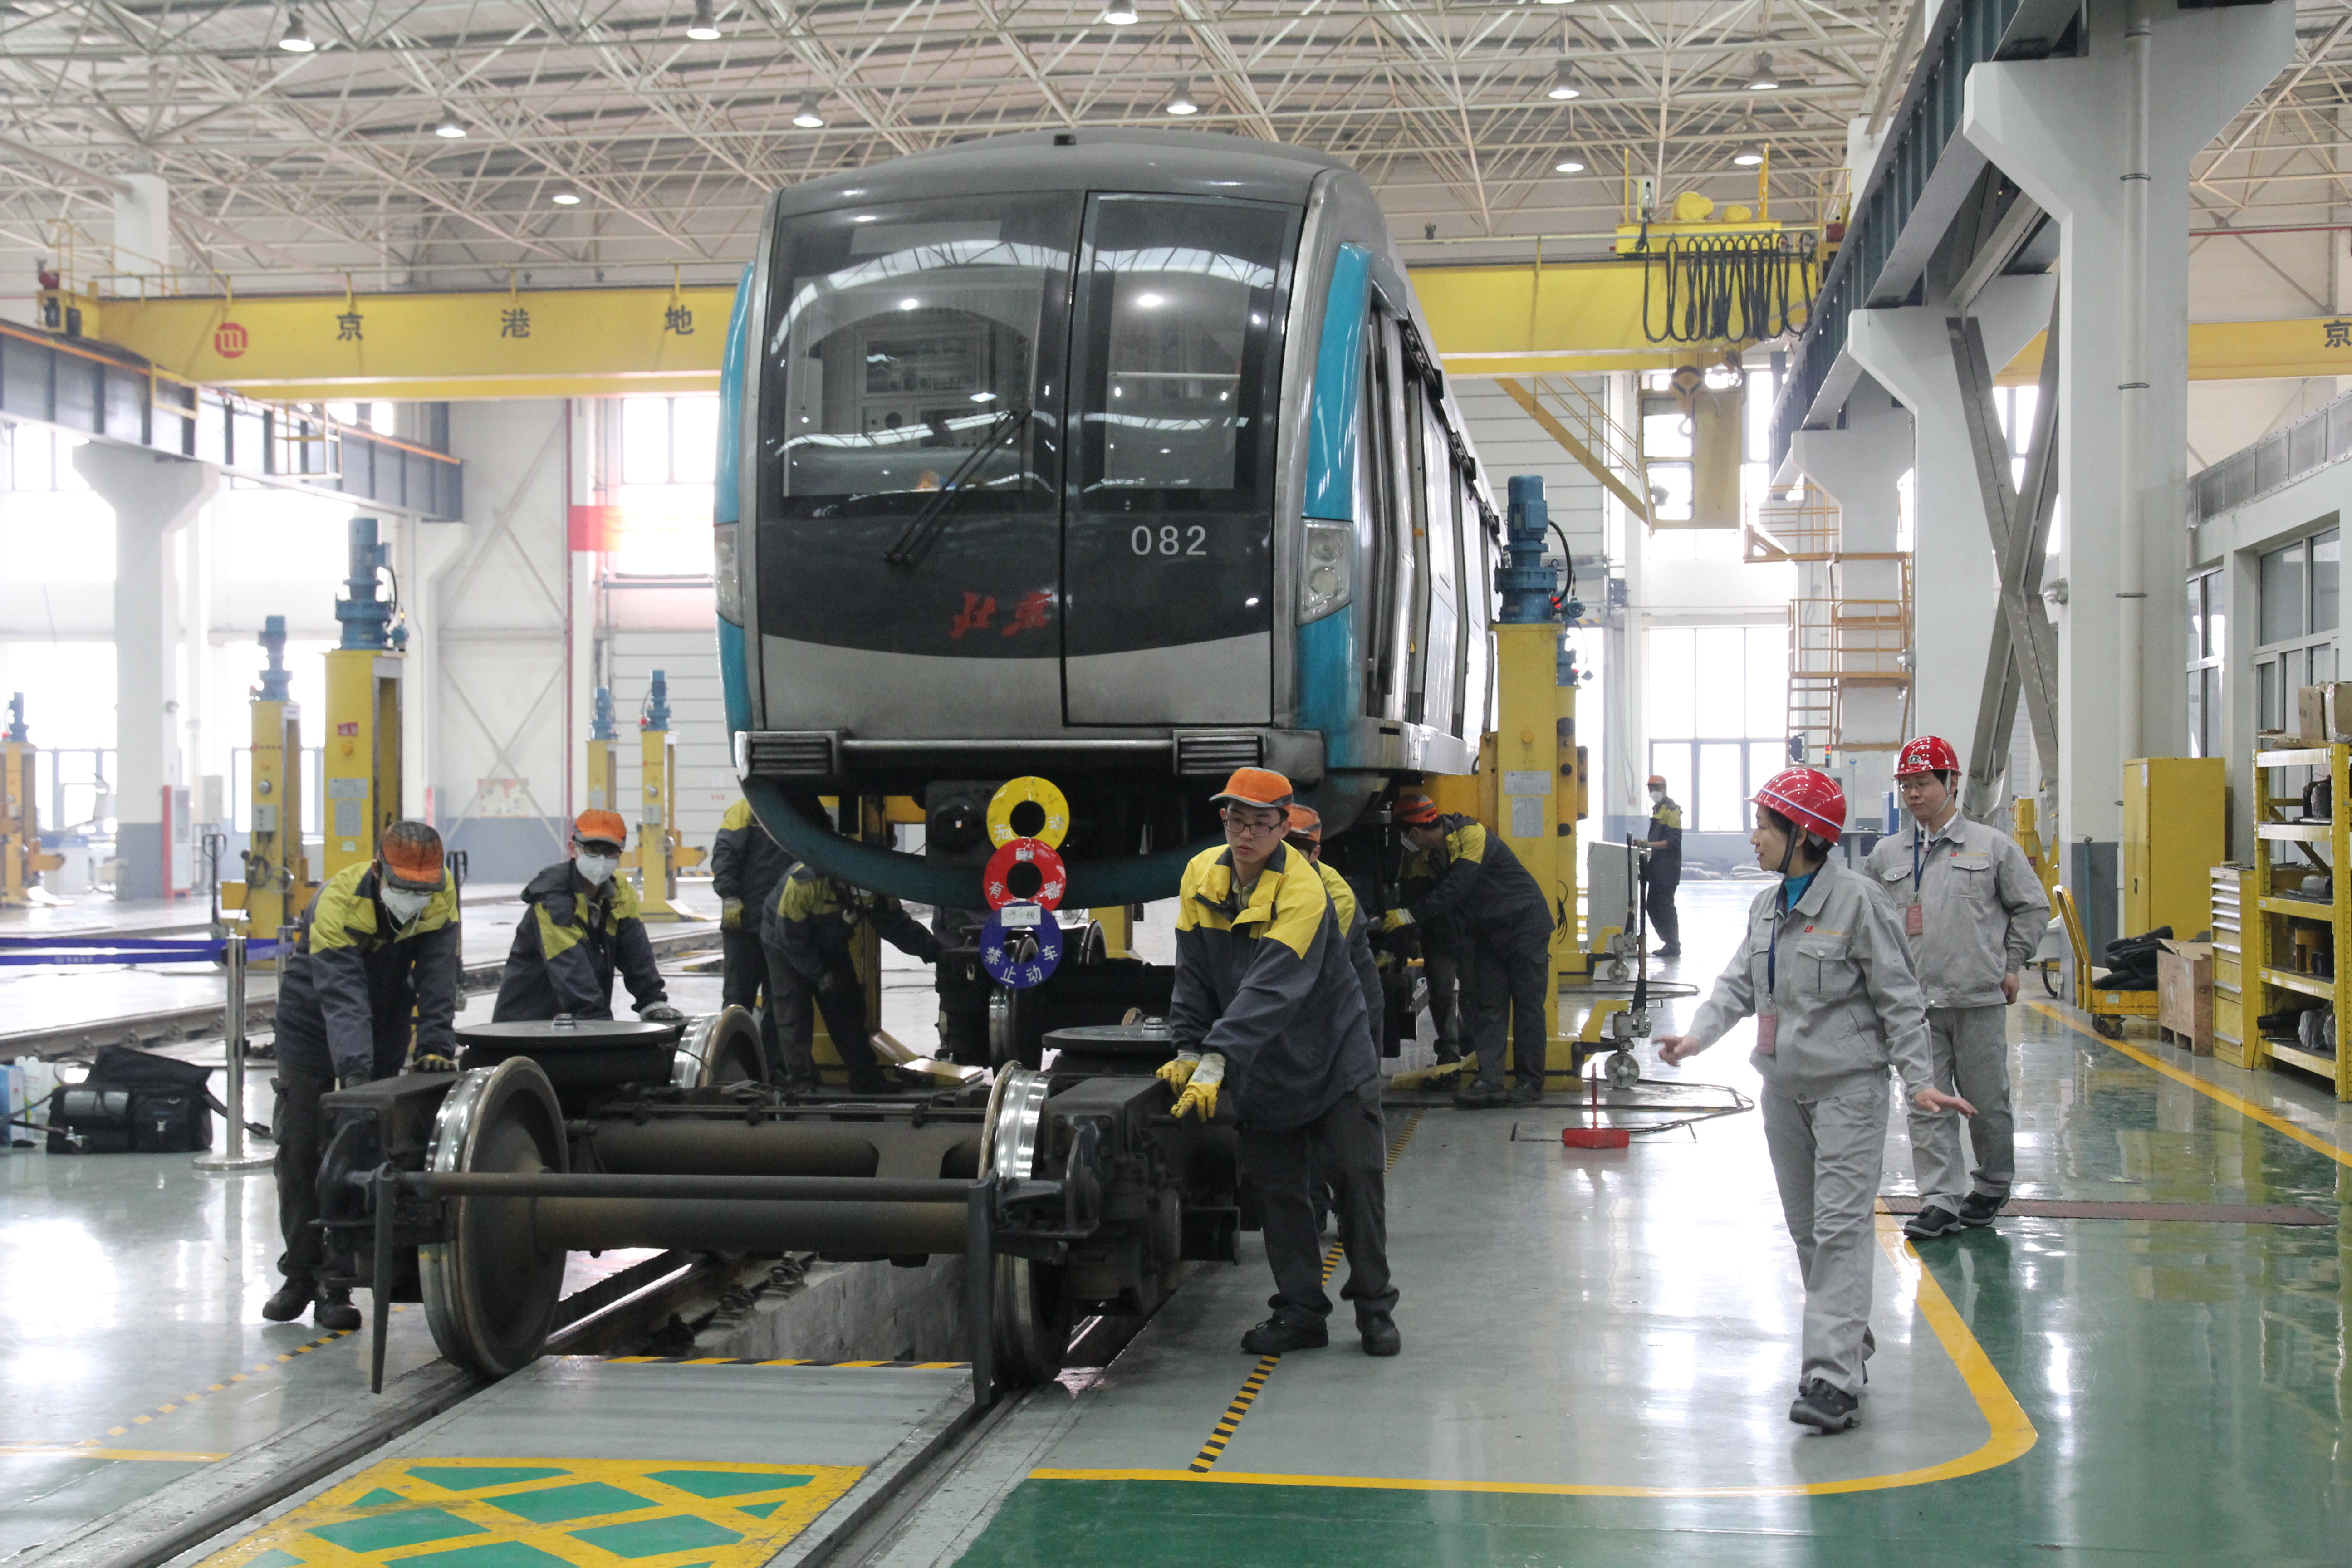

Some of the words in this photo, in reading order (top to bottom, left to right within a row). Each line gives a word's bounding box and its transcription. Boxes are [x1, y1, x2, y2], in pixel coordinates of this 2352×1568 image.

[2323, 320, 2352, 348] 京
[1131, 525, 1207, 556] 082
[949, 591, 1054, 639] 北京
[985, 945, 1058, 984] 禁止动车
